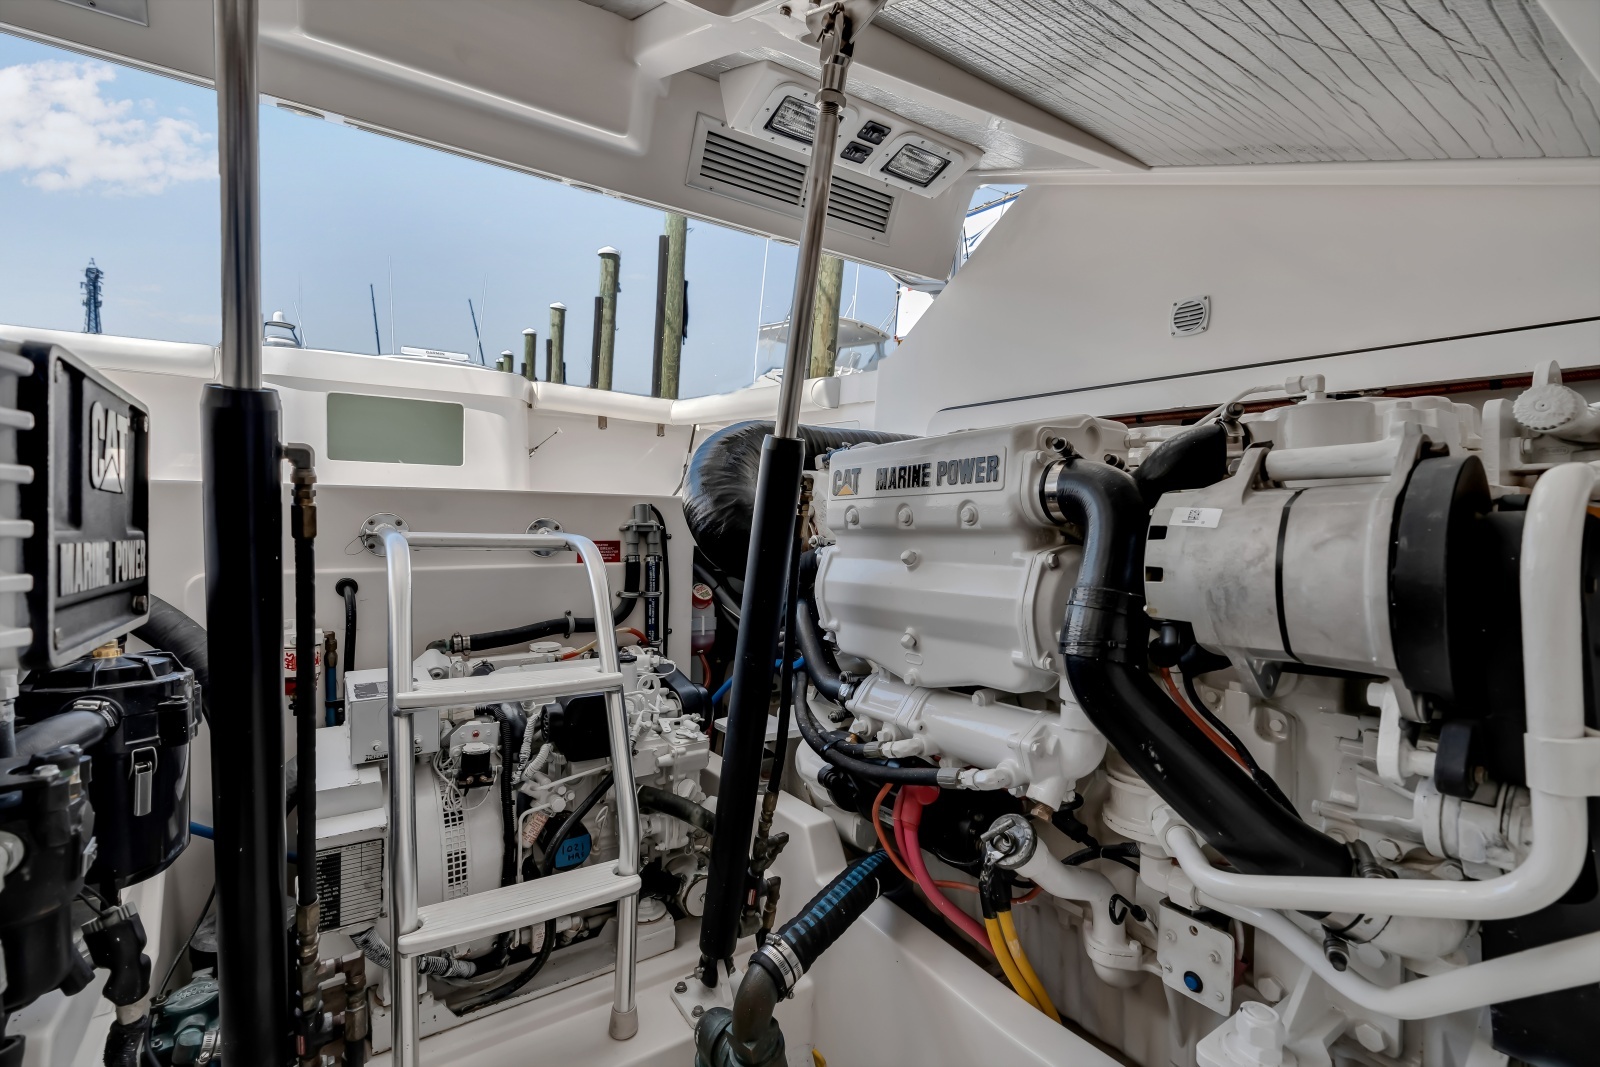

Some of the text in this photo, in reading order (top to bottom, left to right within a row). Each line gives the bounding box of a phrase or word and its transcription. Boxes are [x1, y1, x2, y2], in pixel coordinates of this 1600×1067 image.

[89, 401, 128, 494] CAT
[832, 455, 999, 497] CAT MARINE POWER
[58, 539, 146, 597] MARINE POWER
